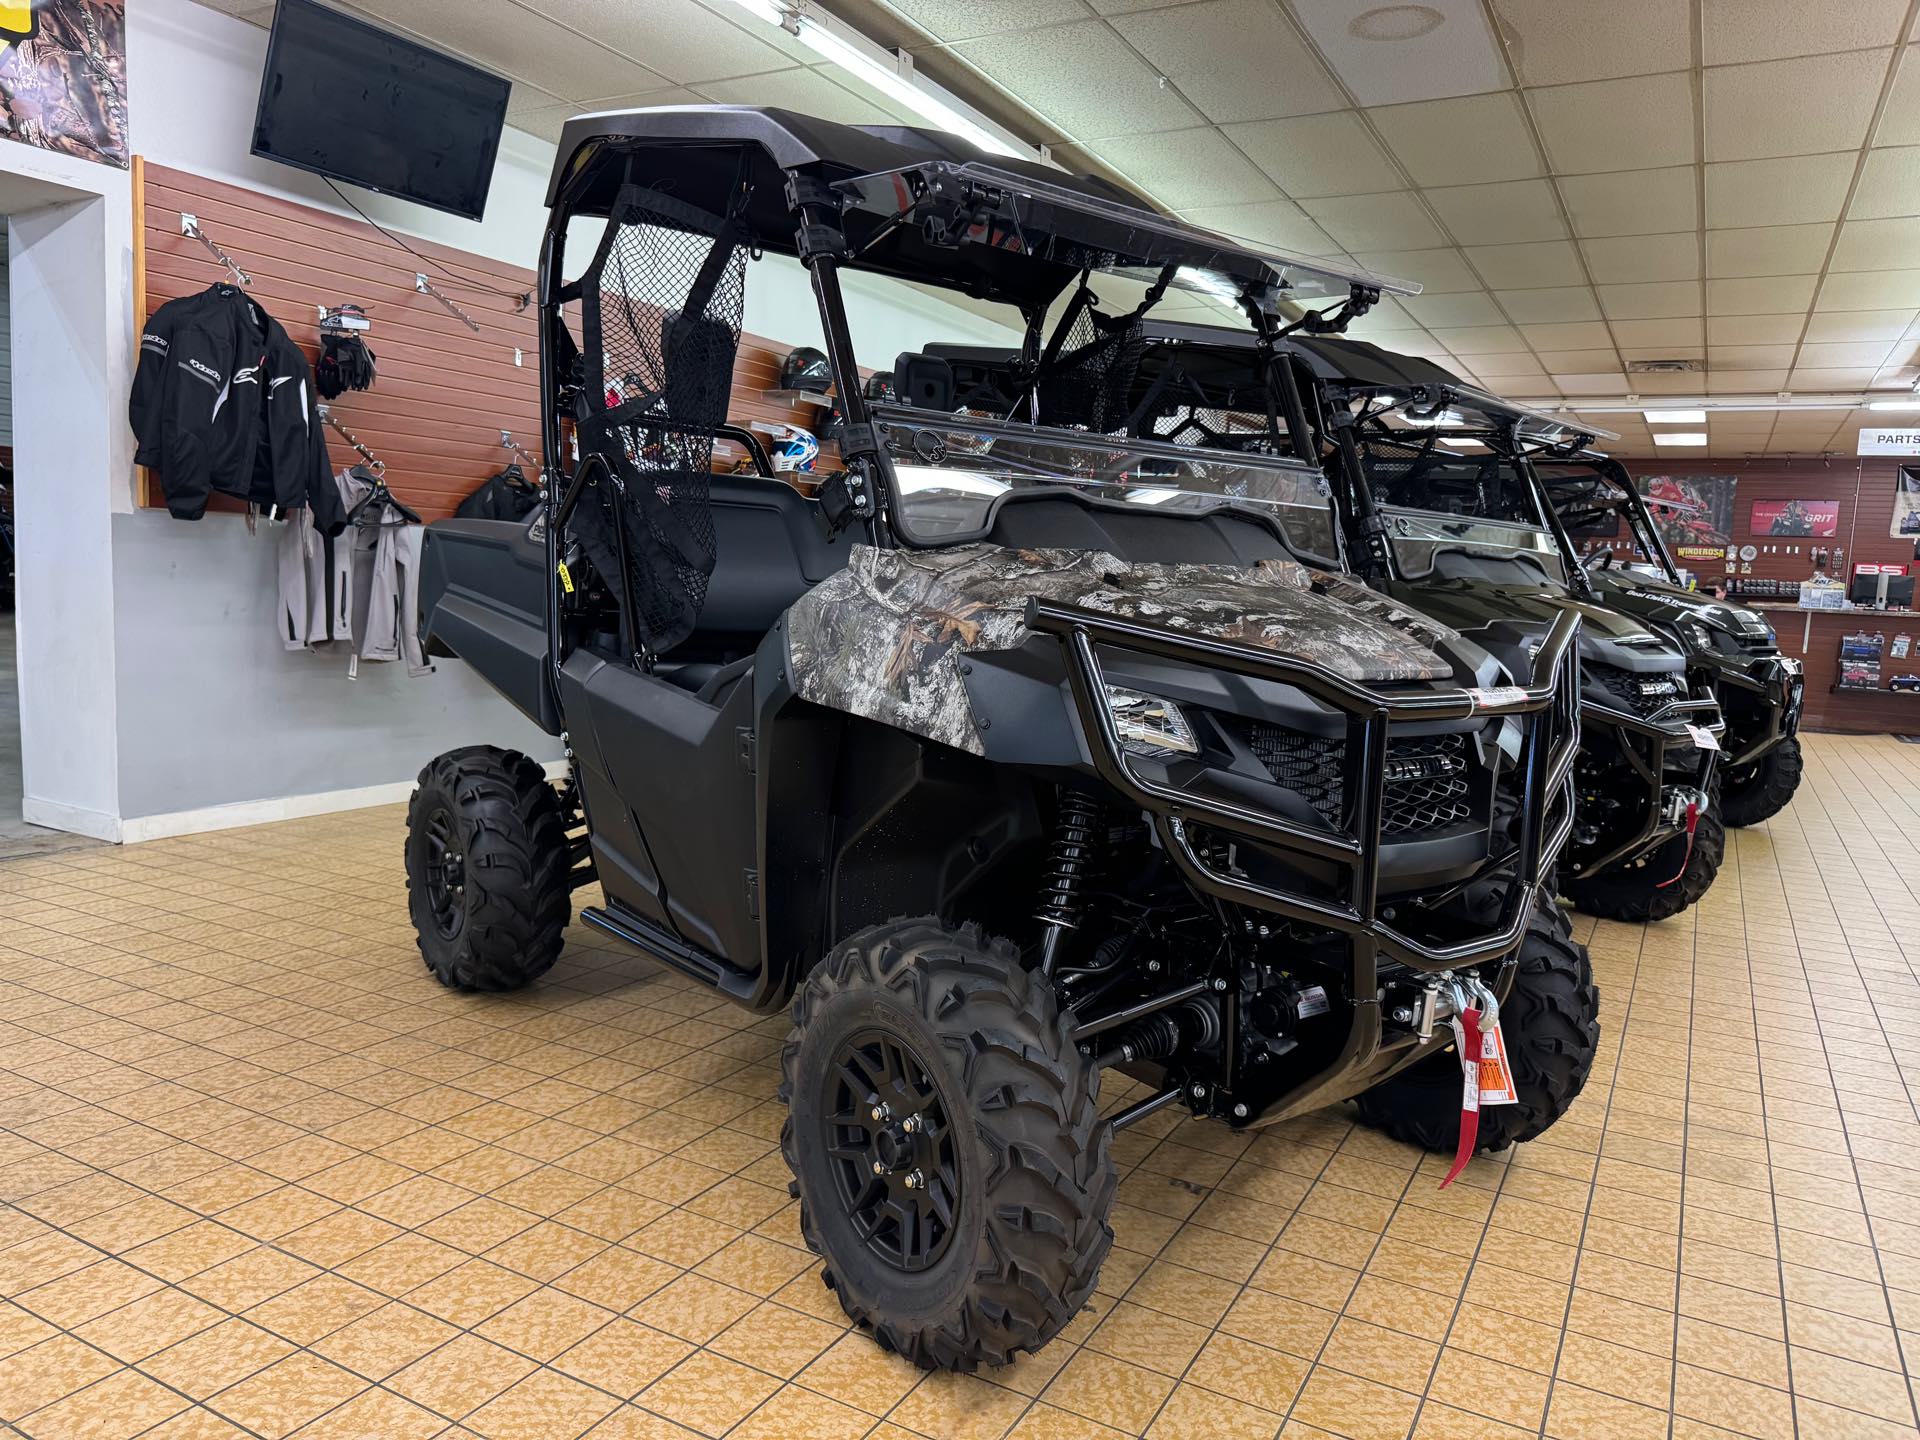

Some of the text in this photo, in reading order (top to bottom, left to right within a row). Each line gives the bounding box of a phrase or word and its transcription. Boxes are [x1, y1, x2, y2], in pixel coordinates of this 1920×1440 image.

[1877, 434, 1920, 444] PARTS
[1805, 513, 1834, 523] GRIT
[1677, 547, 1725, 558] WINDEROSA
[1856, 564, 1903, 576] BS
[1626, 590, 1646, 598] Dual
[1645, 594, 1671, 604] Clutch
